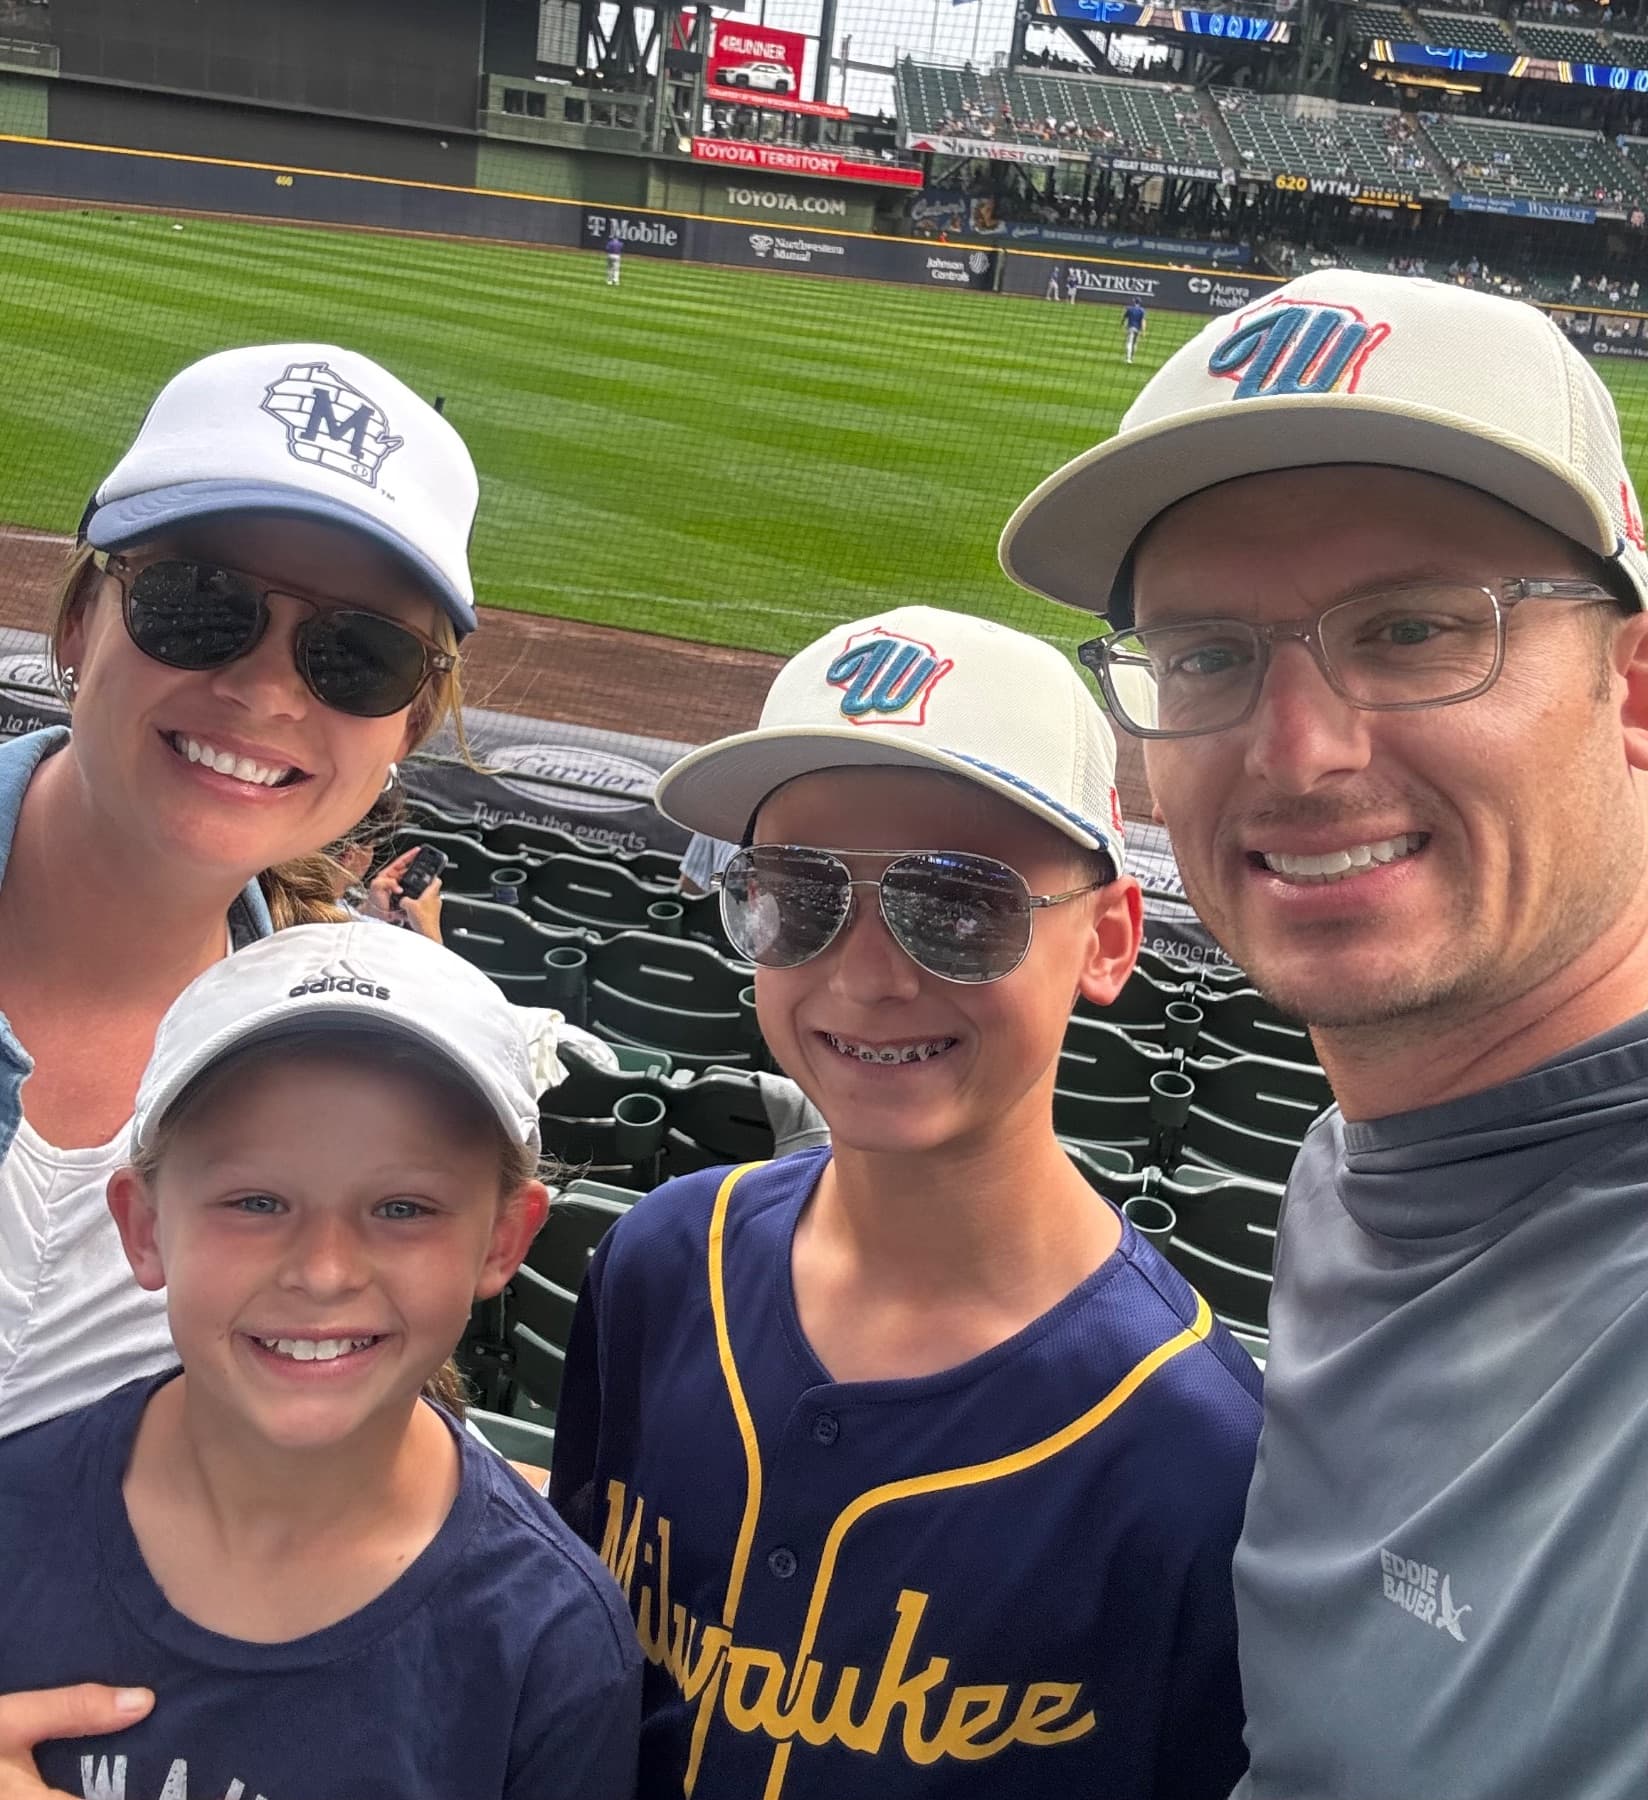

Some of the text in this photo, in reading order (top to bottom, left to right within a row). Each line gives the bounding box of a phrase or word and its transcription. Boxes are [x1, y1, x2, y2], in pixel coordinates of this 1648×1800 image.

[719, 35, 786, 60] 4RUNNER
[697, 142, 839, 172] TOYOTA TERRITORY
[1275, 174, 1308, 192] 620
[1310, 178, 1361, 197] WTMJ
[727, 187, 846, 216] TOYOTA.COM
[1528, 201, 1590, 221] WINTRUST
[608, 218, 678, 246] Mobile
[773, 248, 811, 262] Mutual
[774, 236, 845, 255] Northwestern
[926, 257, 965, 271] Johnson
[931, 268, 970, 282] Controls
[1069, 268, 1155, 293] WINTRUST
[1212, 283, 1250, 298] Aurora
[1210, 294, 1247, 308] Health
[301, 387, 375, 459] M
[7, 713, 23, 728] to
[512, 753, 646, 793] Carrier
[474, 801, 646, 850] Turn to the experts
[1152, 936, 1233, 967] experts
[288, 977, 391, 1001] adidas
[1381, 1548, 1438, 1595] EDDIE
[1383, 1572, 1436, 1625] BAUER
[600, 1479, 1096, 1765] Milwaukee
[80, 1754, 268, 1800] WA
